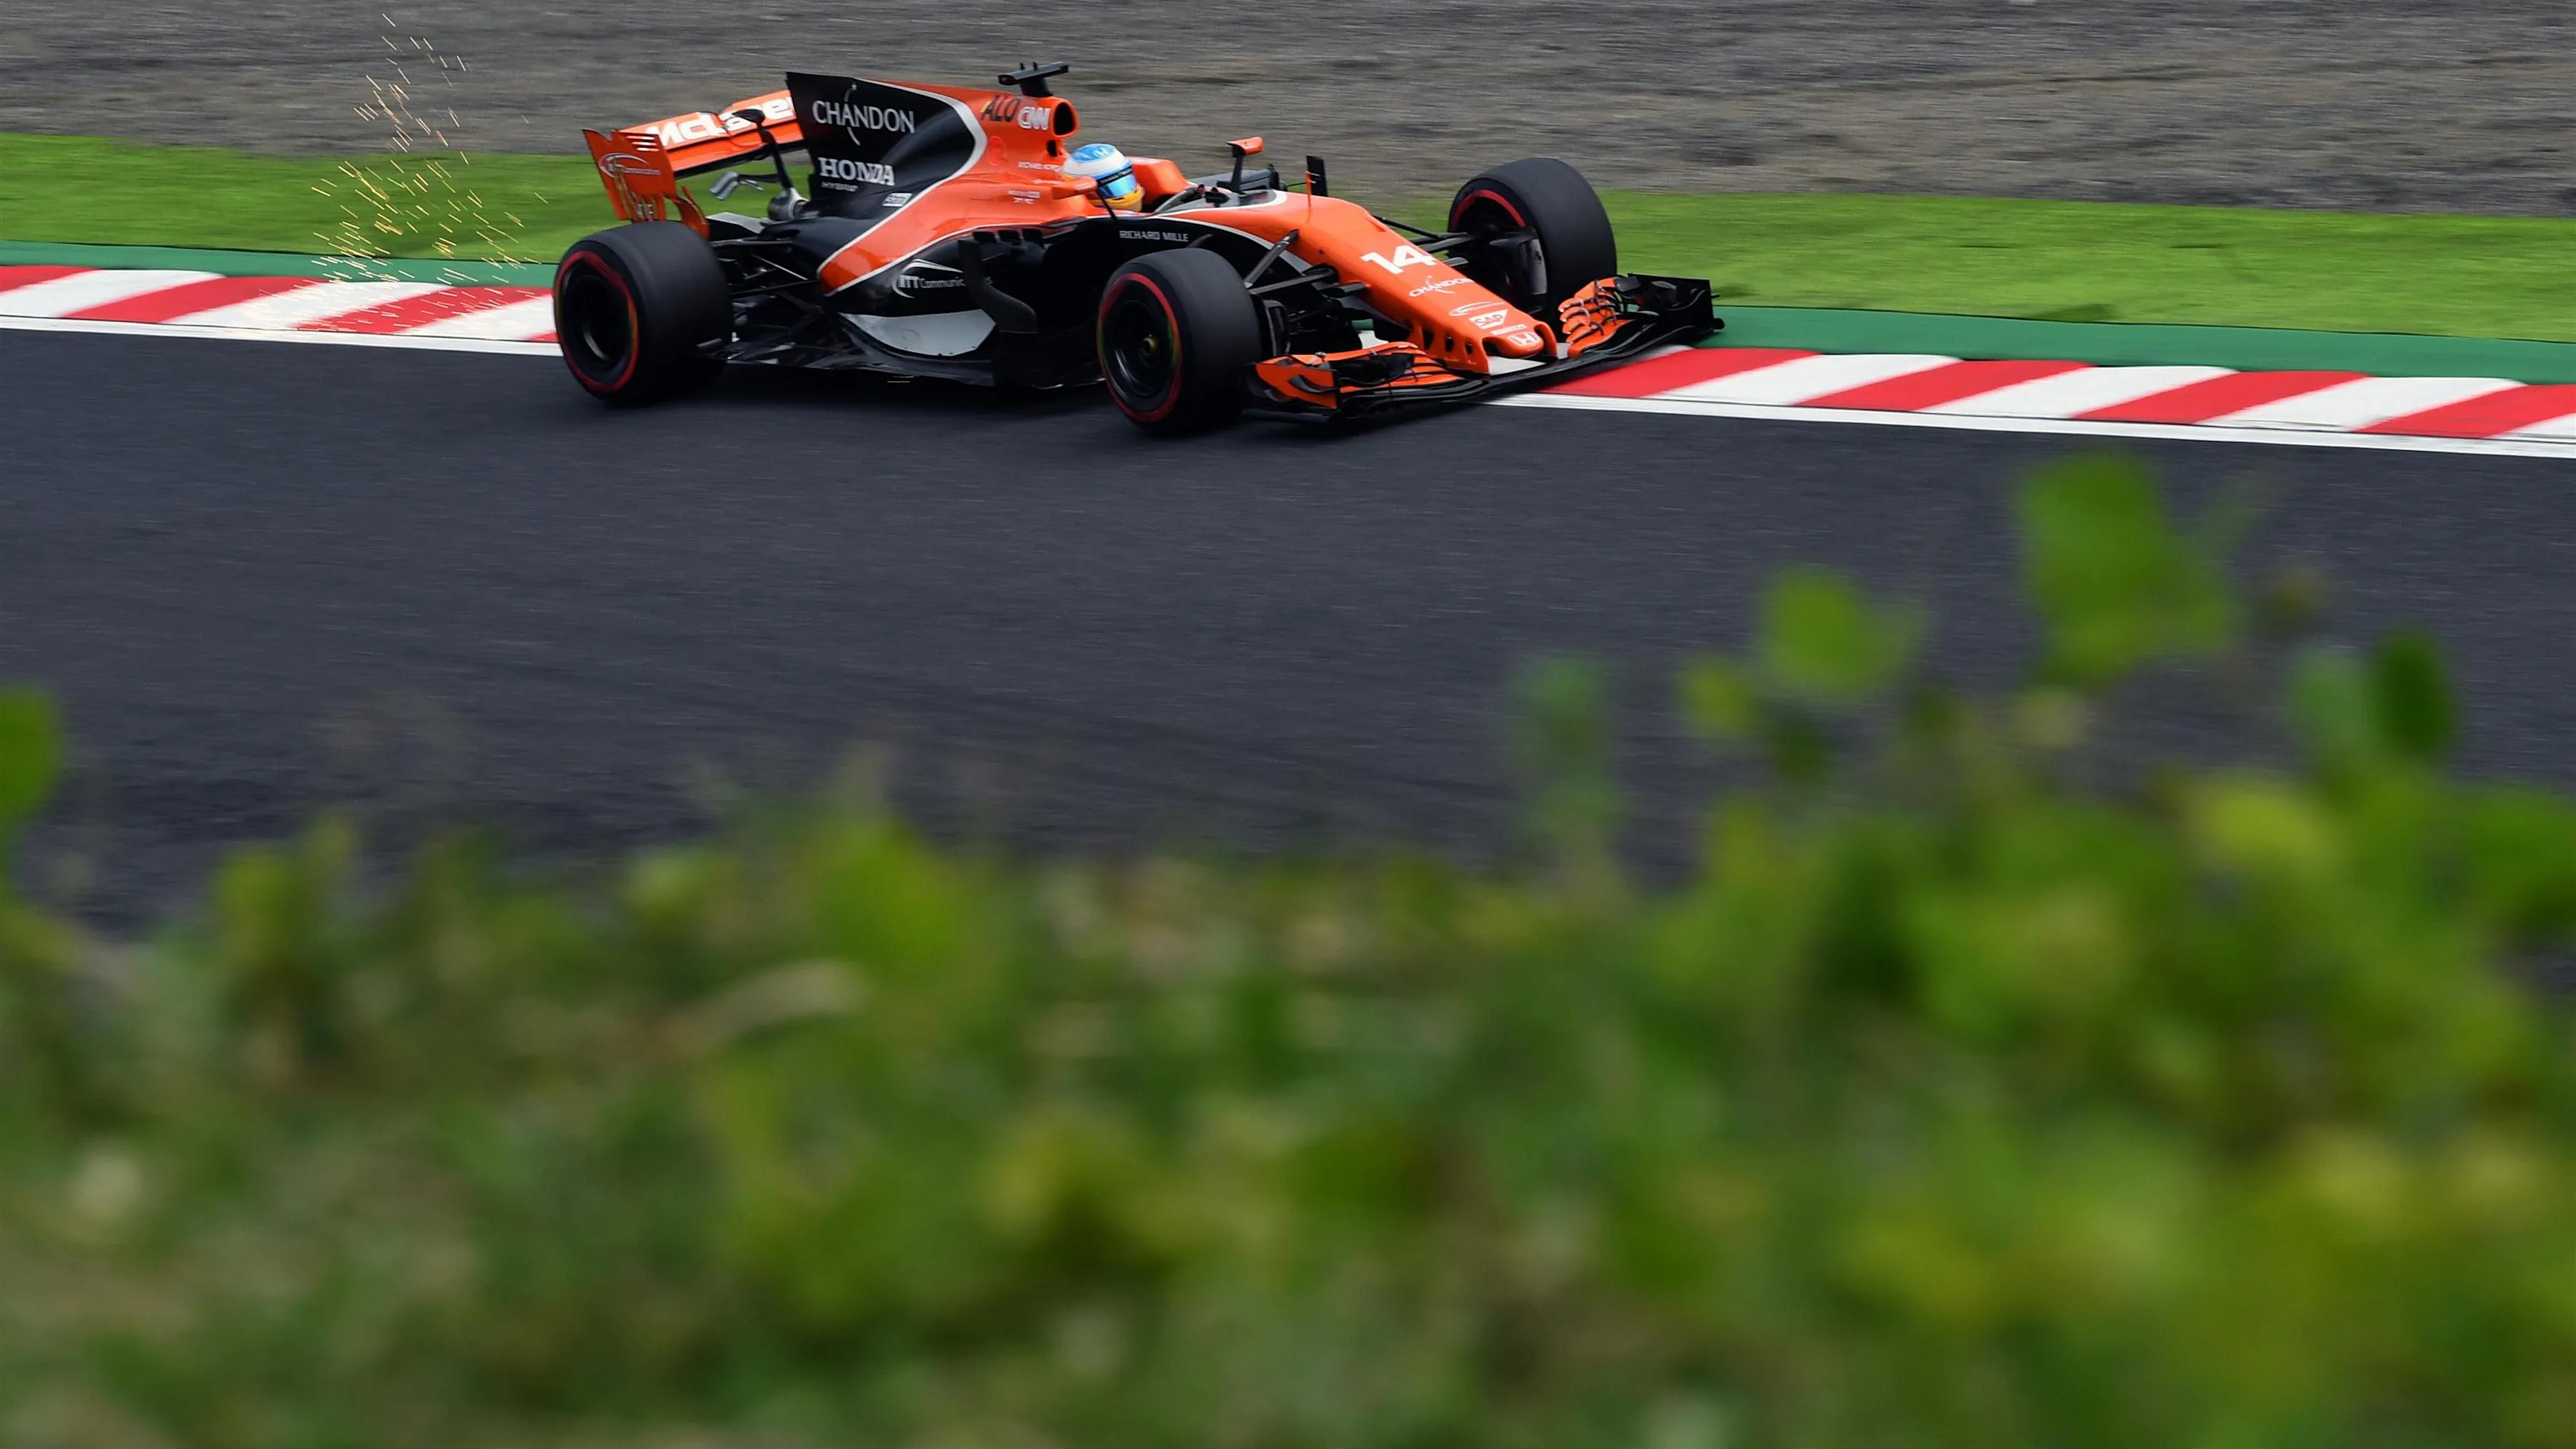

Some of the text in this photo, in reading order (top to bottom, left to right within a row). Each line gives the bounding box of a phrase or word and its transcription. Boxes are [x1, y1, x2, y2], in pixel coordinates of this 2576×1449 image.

[645, 96, 795, 147] McLae
[812, 99, 915, 134] CHANDON
[1018, 106, 1051, 131] CNN
[818, 156, 895, 186] HONDA
[1119, 230, 1189, 242] RICHARD MILLE
[1359, 245, 1437, 274] 14
[1474, 314, 1504, 327] SAP
